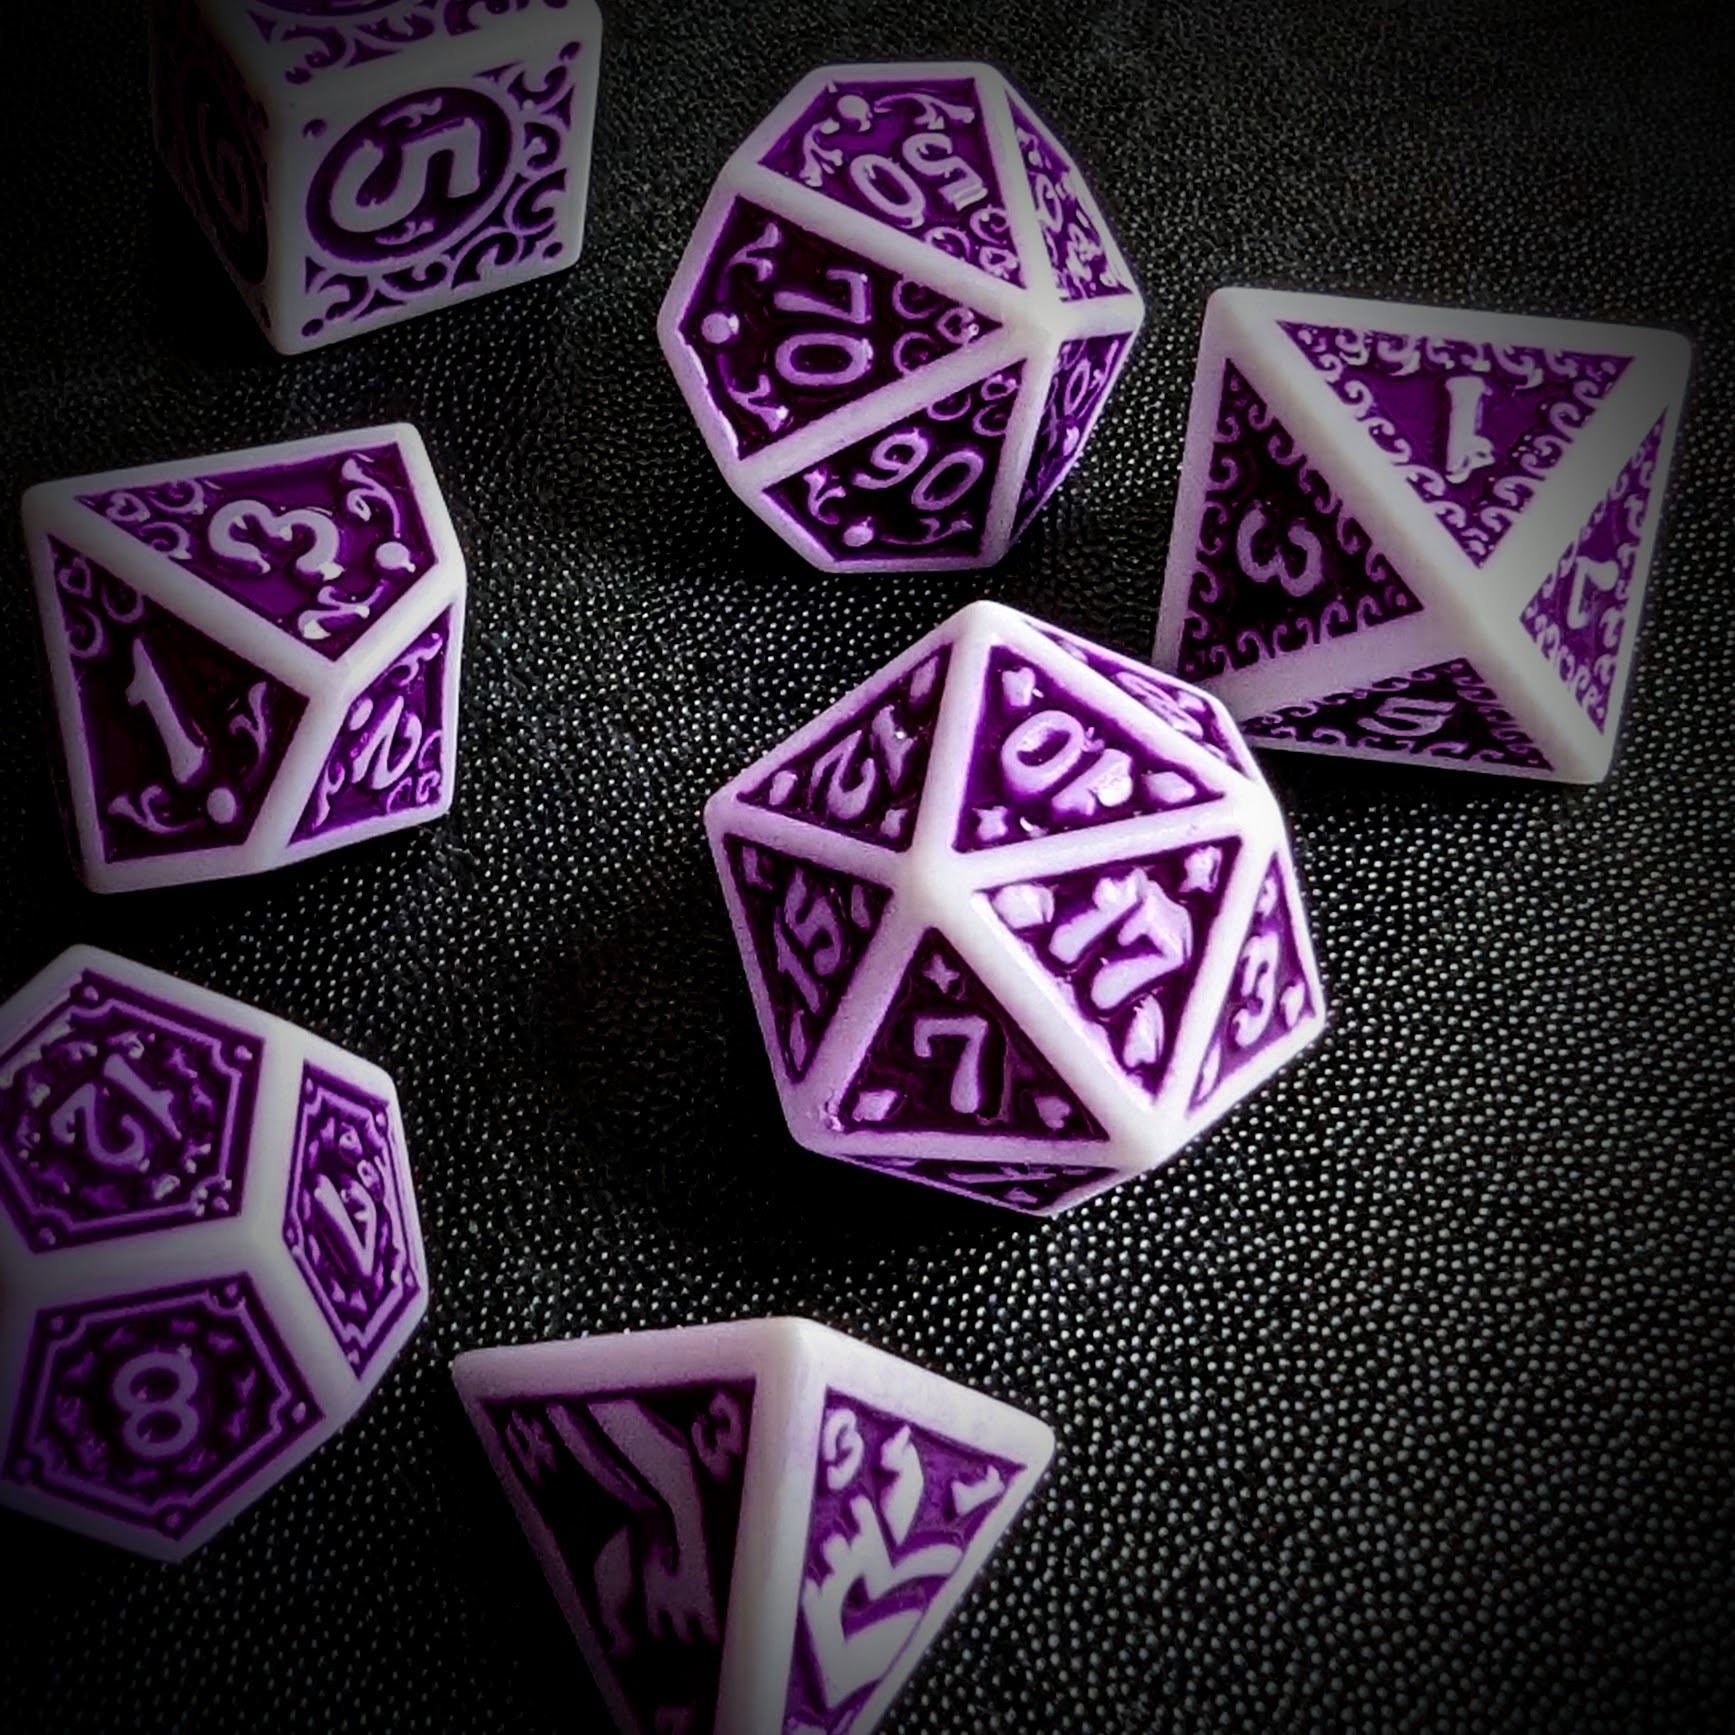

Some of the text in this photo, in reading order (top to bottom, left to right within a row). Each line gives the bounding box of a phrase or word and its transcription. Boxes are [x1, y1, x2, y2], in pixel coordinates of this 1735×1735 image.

[328, 115, 481, 233] 5
[849, 132, 988, 229] 50
[772, 268, 874, 386] 70
[849, 427, 986, 511] 90
[1444, 375, 1494, 484] 1
[207, 499, 346, 581] 3
[1234, 506, 1325, 598] 3
[126, 636, 204, 785] 1
[351, 695, 422, 791] 2
[811, 704, 912, 820] 12
[1002, 710, 1133, 817] 10
[774, 867, 842, 1014] 15
[1049, 867, 1194, 1011] 17
[1231, 933, 1279, 1047] 3
[50, 1052, 181, 1173] 12
[913, 1016, 987, 1113] 7
[111, 1344, 201, 1461] 8
[823, 1407, 864, 1492] 3
